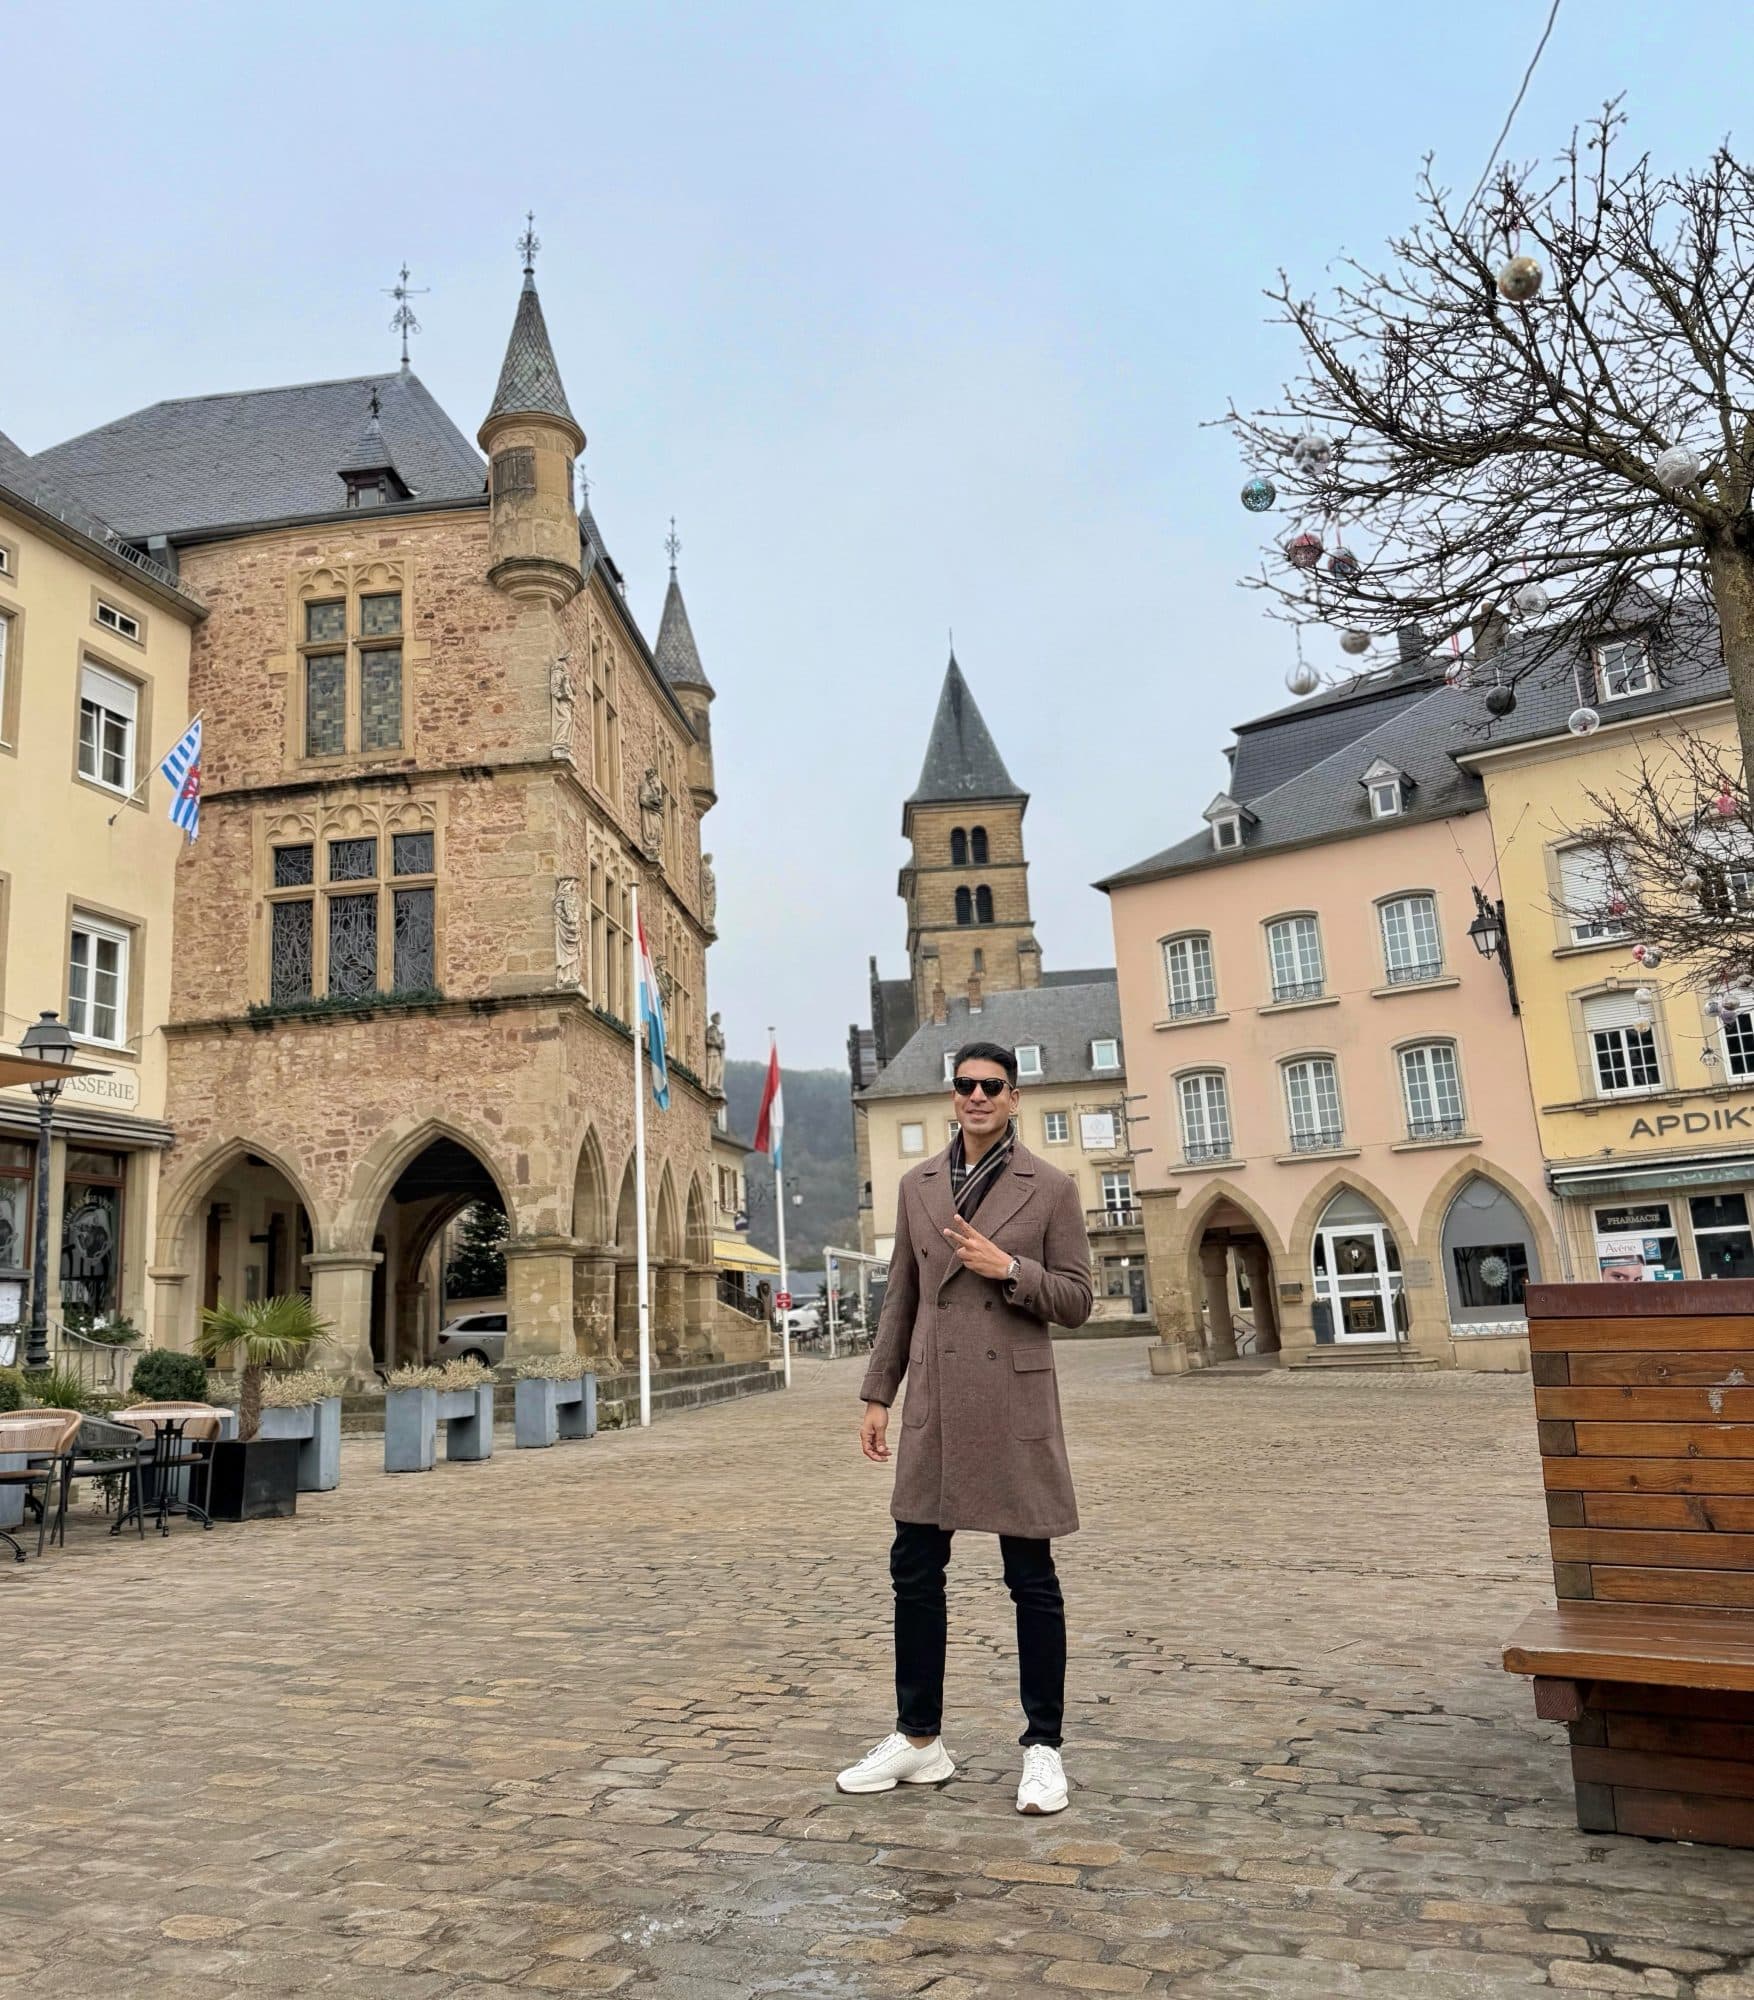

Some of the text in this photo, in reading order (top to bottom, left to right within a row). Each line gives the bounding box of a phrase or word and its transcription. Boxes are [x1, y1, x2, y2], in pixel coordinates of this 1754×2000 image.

[65, 1076, 134, 1101] ASSERIE
[1629, 1105, 1754, 1139] APDIK
[1606, 1214, 1660, 1225] PHARMACIE
